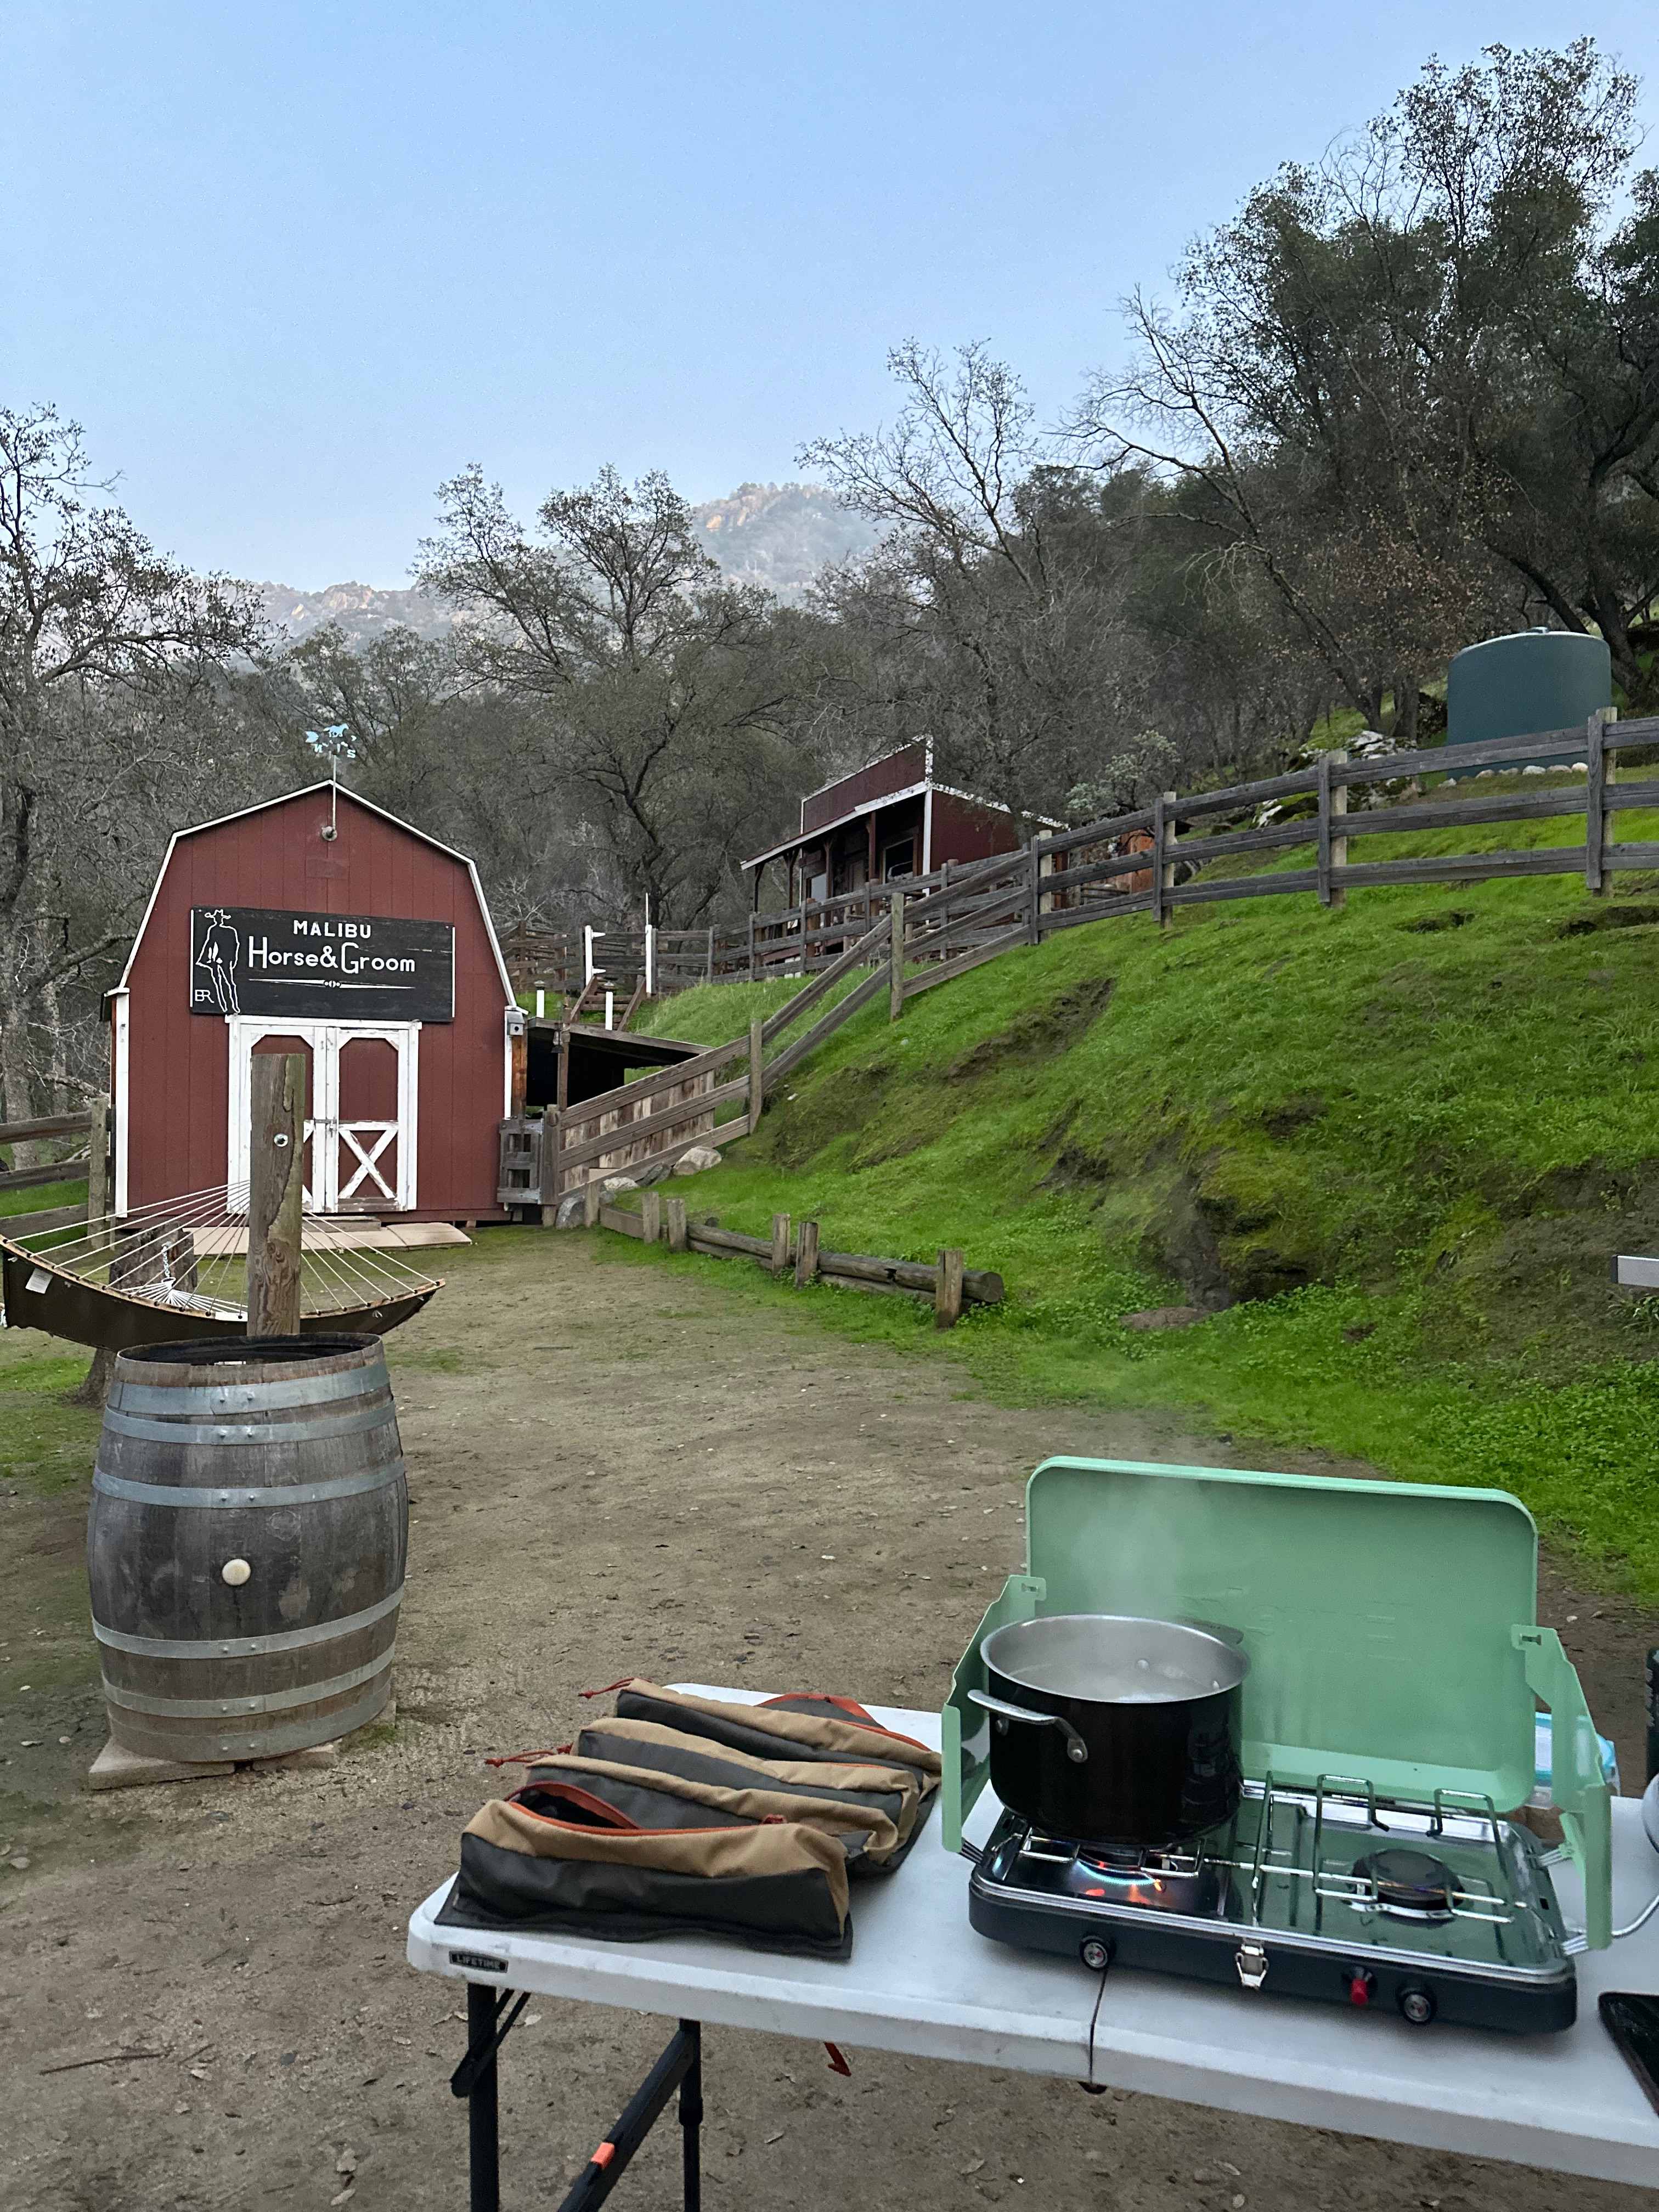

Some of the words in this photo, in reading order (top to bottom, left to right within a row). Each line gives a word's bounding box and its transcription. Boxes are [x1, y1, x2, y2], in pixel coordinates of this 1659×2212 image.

[347, 749, 356, 758] S
[294, 919, 371, 939] MALIBU
[249, 935, 415, 974] Horse&Groom
[456, 1954, 500, 1970] LIFETIME
